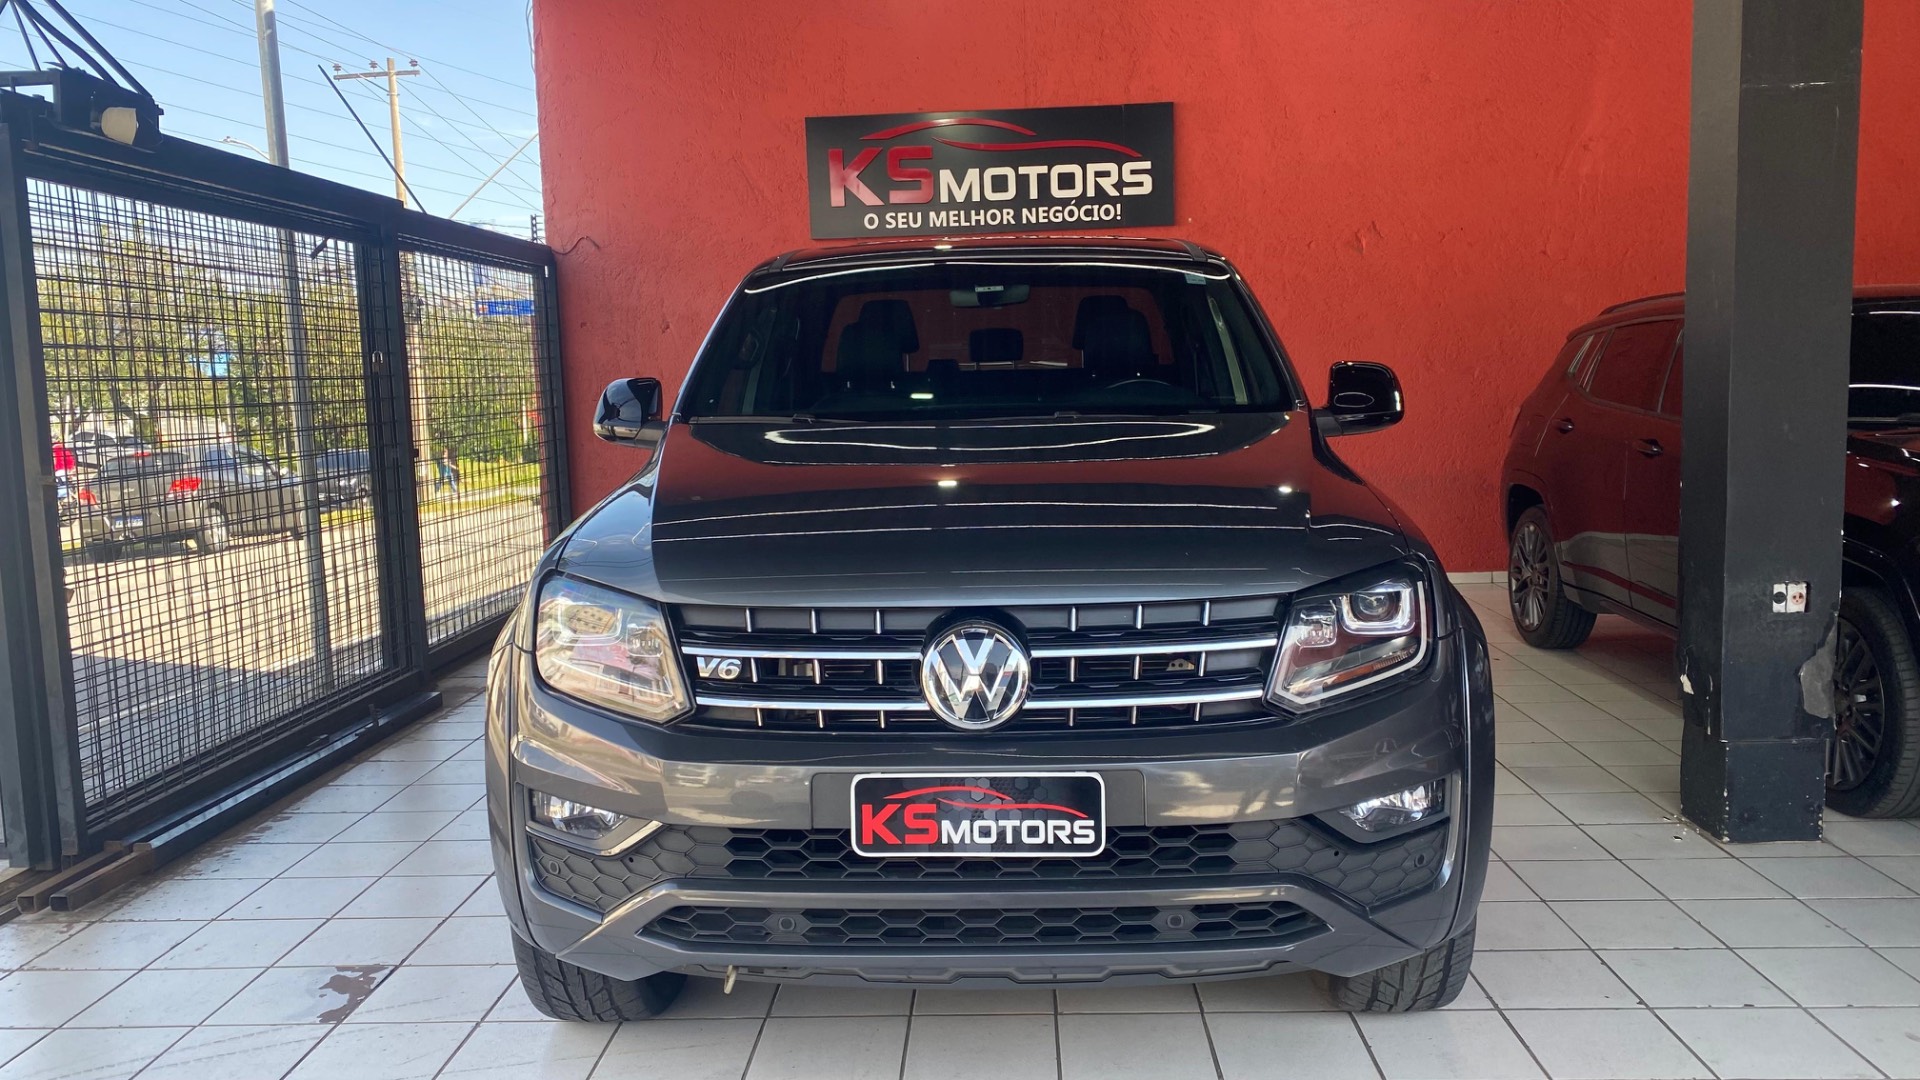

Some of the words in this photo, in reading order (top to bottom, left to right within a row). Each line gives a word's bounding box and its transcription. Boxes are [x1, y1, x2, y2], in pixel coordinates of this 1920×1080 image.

[828, 145, 935, 208] KS
[939, 160, 1153, 204] MOTORS
[863, 212, 880, 230] O
[885, 211, 922, 229] SEU
[929, 206, 1016, 228] MELHOR
[1022, 200, 1122, 225] NEGÓCIO!
[696, 656, 741, 680] V6
[861, 803, 939, 845] KS
[941, 819, 1096, 845] MOTORS
